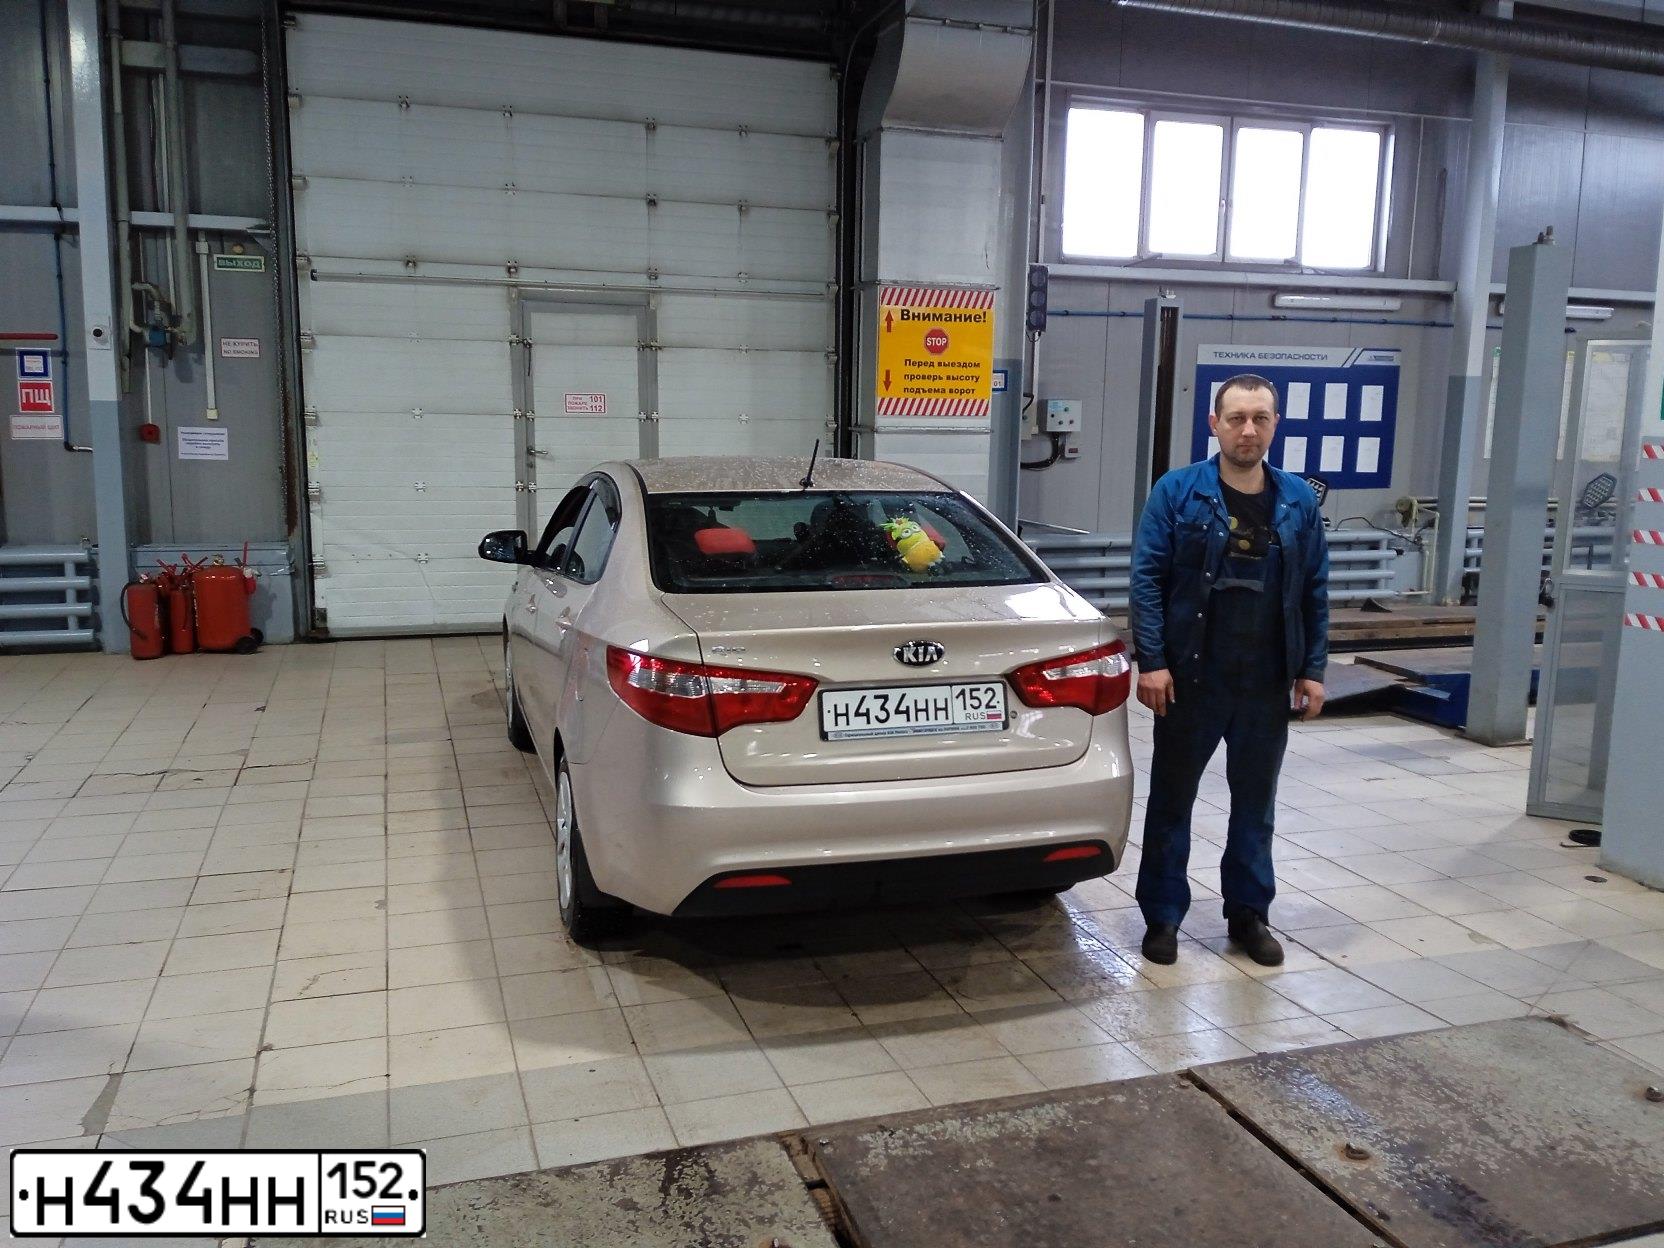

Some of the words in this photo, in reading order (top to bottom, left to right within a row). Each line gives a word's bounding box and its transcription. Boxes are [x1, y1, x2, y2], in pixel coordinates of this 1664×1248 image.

[218, 259, 261, 269] ВЫХОД
[900, 308, 987, 323] Внимание!
[926, 337, 947, 347] STOP
[1213, 350, 1256, 360] ТЕХНИКА
[1257, 352, 1328, 361] БЕЗОПАСНОСТИ
[904, 358, 935, 368] Перед
[937, 359, 981, 369] выездом
[904, 373, 943, 382] проверь
[946, 374, 980, 383] высоту
[903, 386, 946, 396] подъема
[948, 387, 976, 396] ворот
[21, 388, 51, 406] ПЩ
[590, 395, 603, 403] 101
[590, 404, 603, 412] 112
[902, 646, 938, 663] KIA
[955, 686, 998, 711] 152
